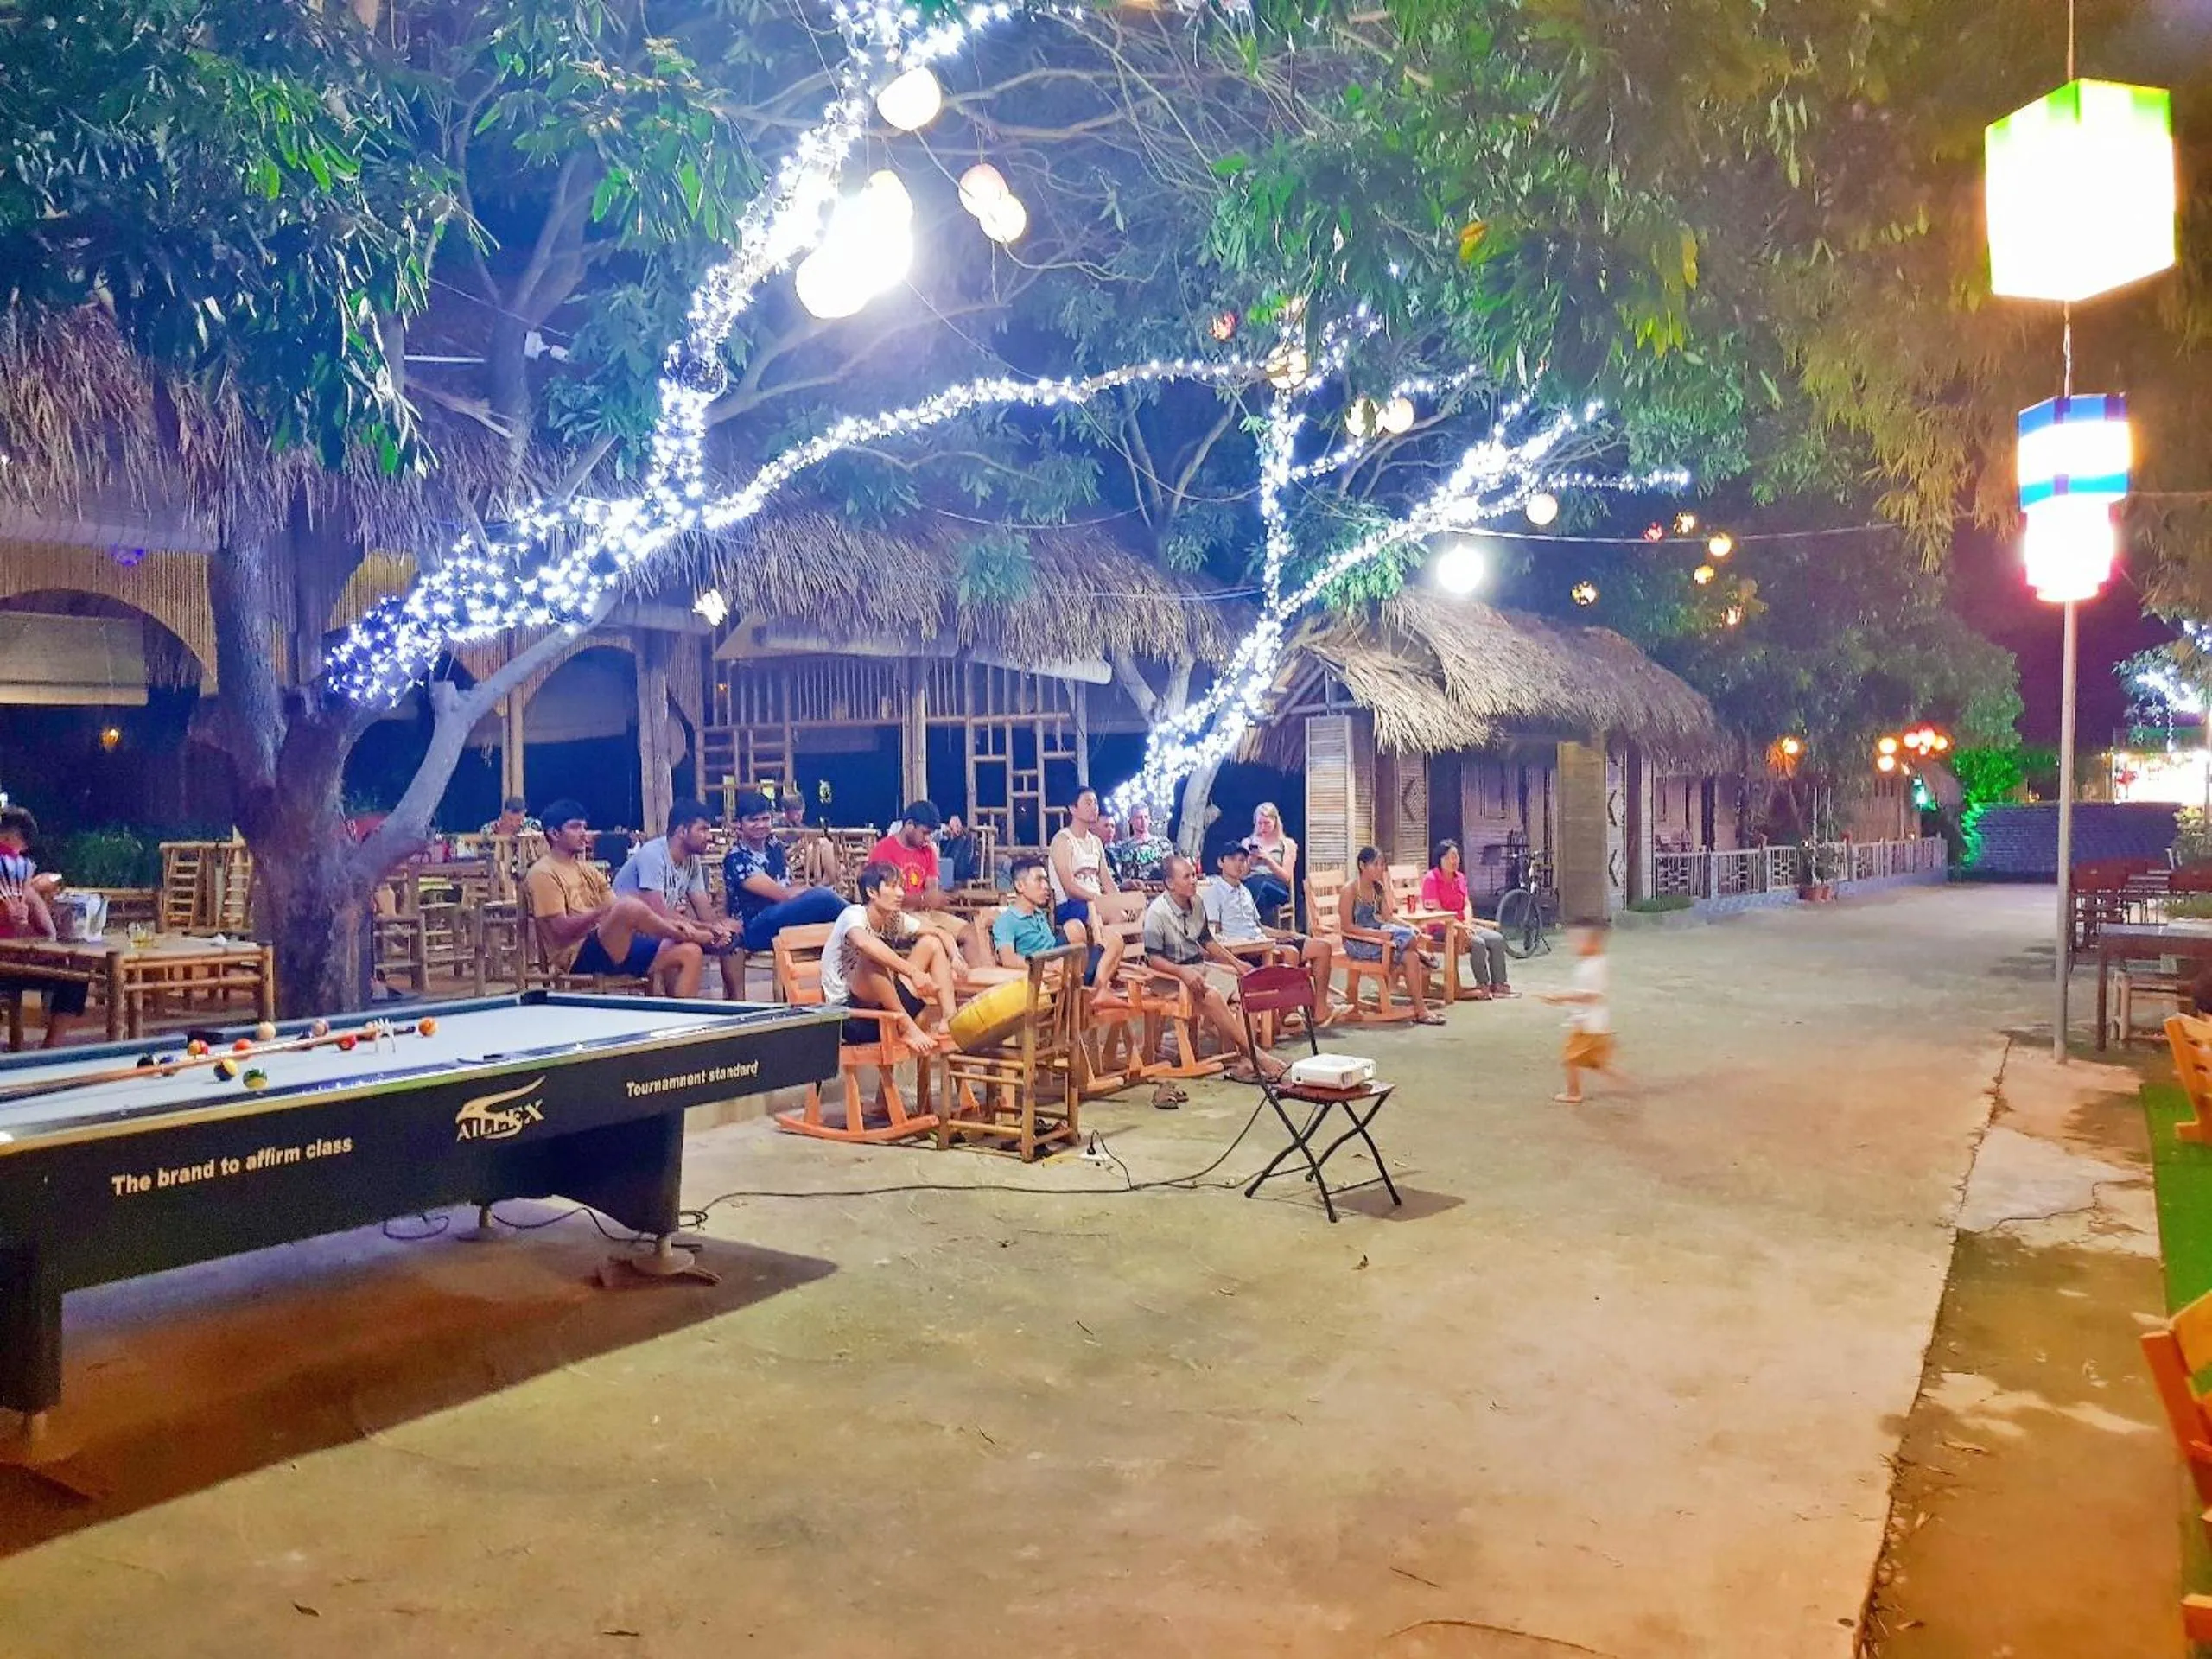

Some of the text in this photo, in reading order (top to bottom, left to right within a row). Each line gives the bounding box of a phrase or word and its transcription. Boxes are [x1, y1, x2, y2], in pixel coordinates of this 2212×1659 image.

[709, 1059, 759, 1083] standard
[111, 1135, 353, 1197] The brand to affirm class
